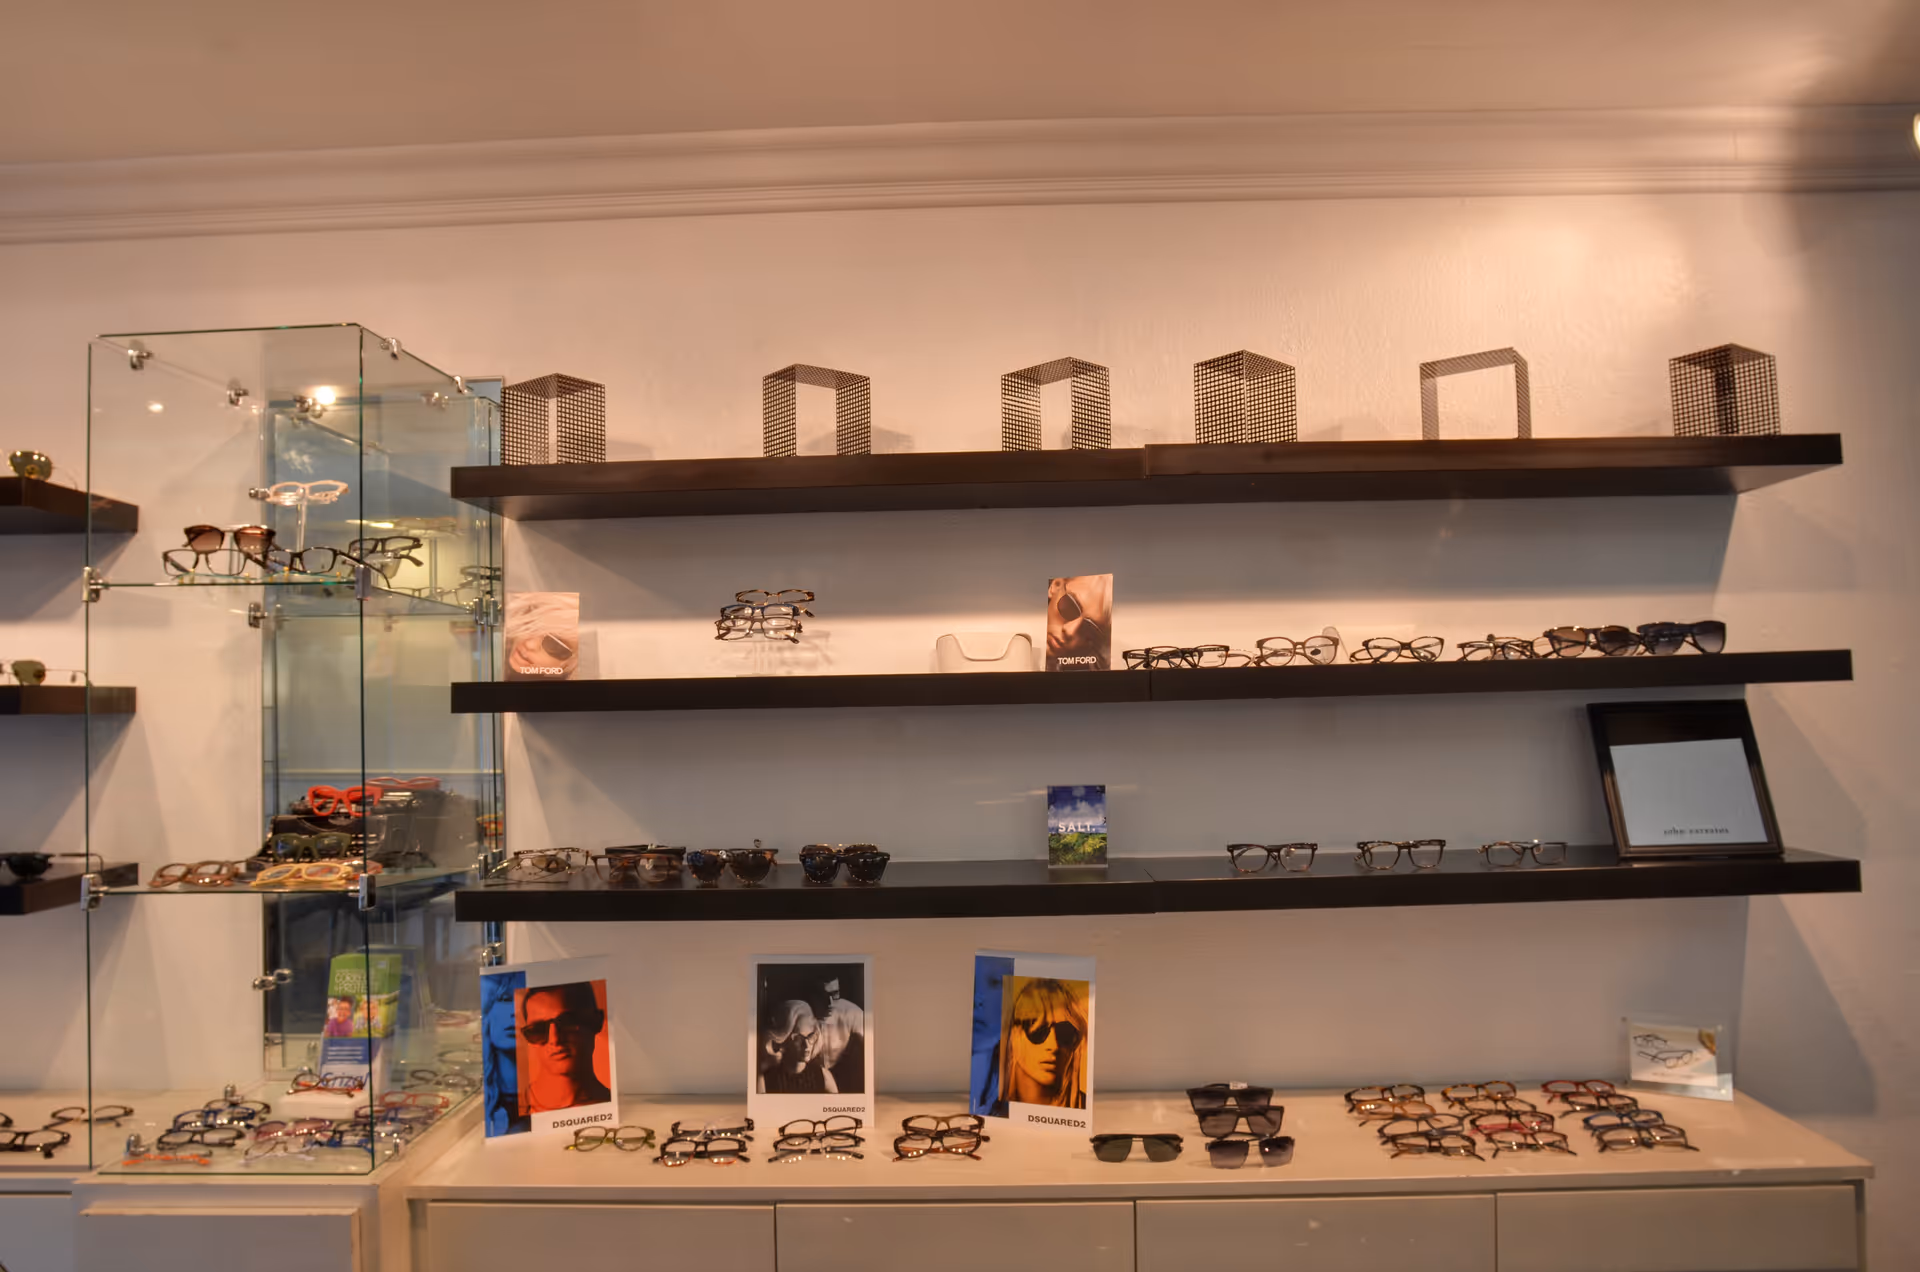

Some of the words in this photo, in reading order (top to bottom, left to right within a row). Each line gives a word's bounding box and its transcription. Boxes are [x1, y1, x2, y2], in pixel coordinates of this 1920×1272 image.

[1057, 657, 1075, 665] TOM
[1075, 656, 1097, 664] FORD
[520, 666, 539, 675] TOM
[540, 667, 564, 675] FORD
[1058, 821, 1096, 832] SALT.
[552, 1113, 613, 1129] DSQUARED2
[1028, 1114, 1087, 1129] DSQUARED2
